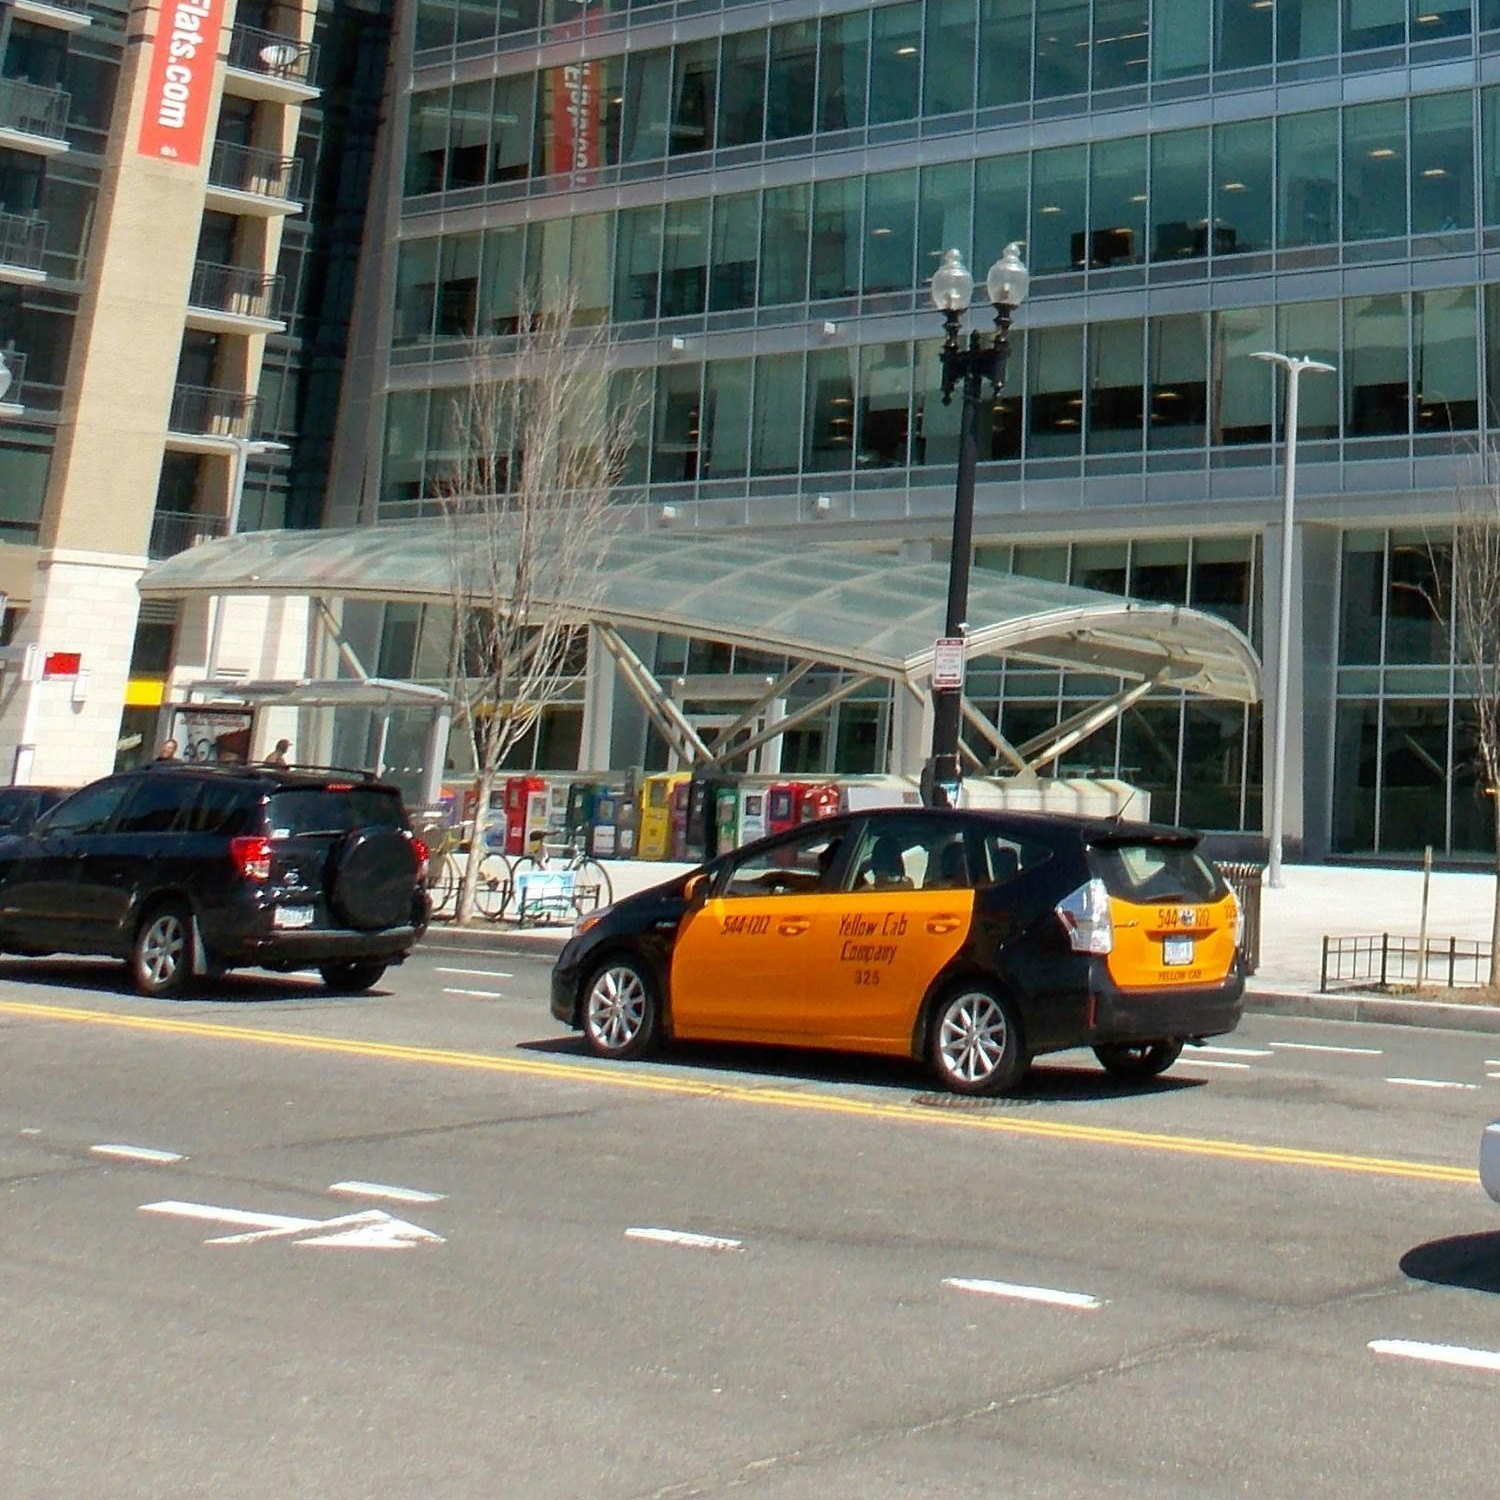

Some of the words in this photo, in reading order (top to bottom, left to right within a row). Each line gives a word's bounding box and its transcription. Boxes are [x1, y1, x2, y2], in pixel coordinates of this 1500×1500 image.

[720, 915, 772, 936] 544-1212
[838, 913, 878, 937] Yellow
[881, 911, 908, 937] Cab
[1157, 907, 1178, 929] 544
[839, 939, 899, 965] Company
